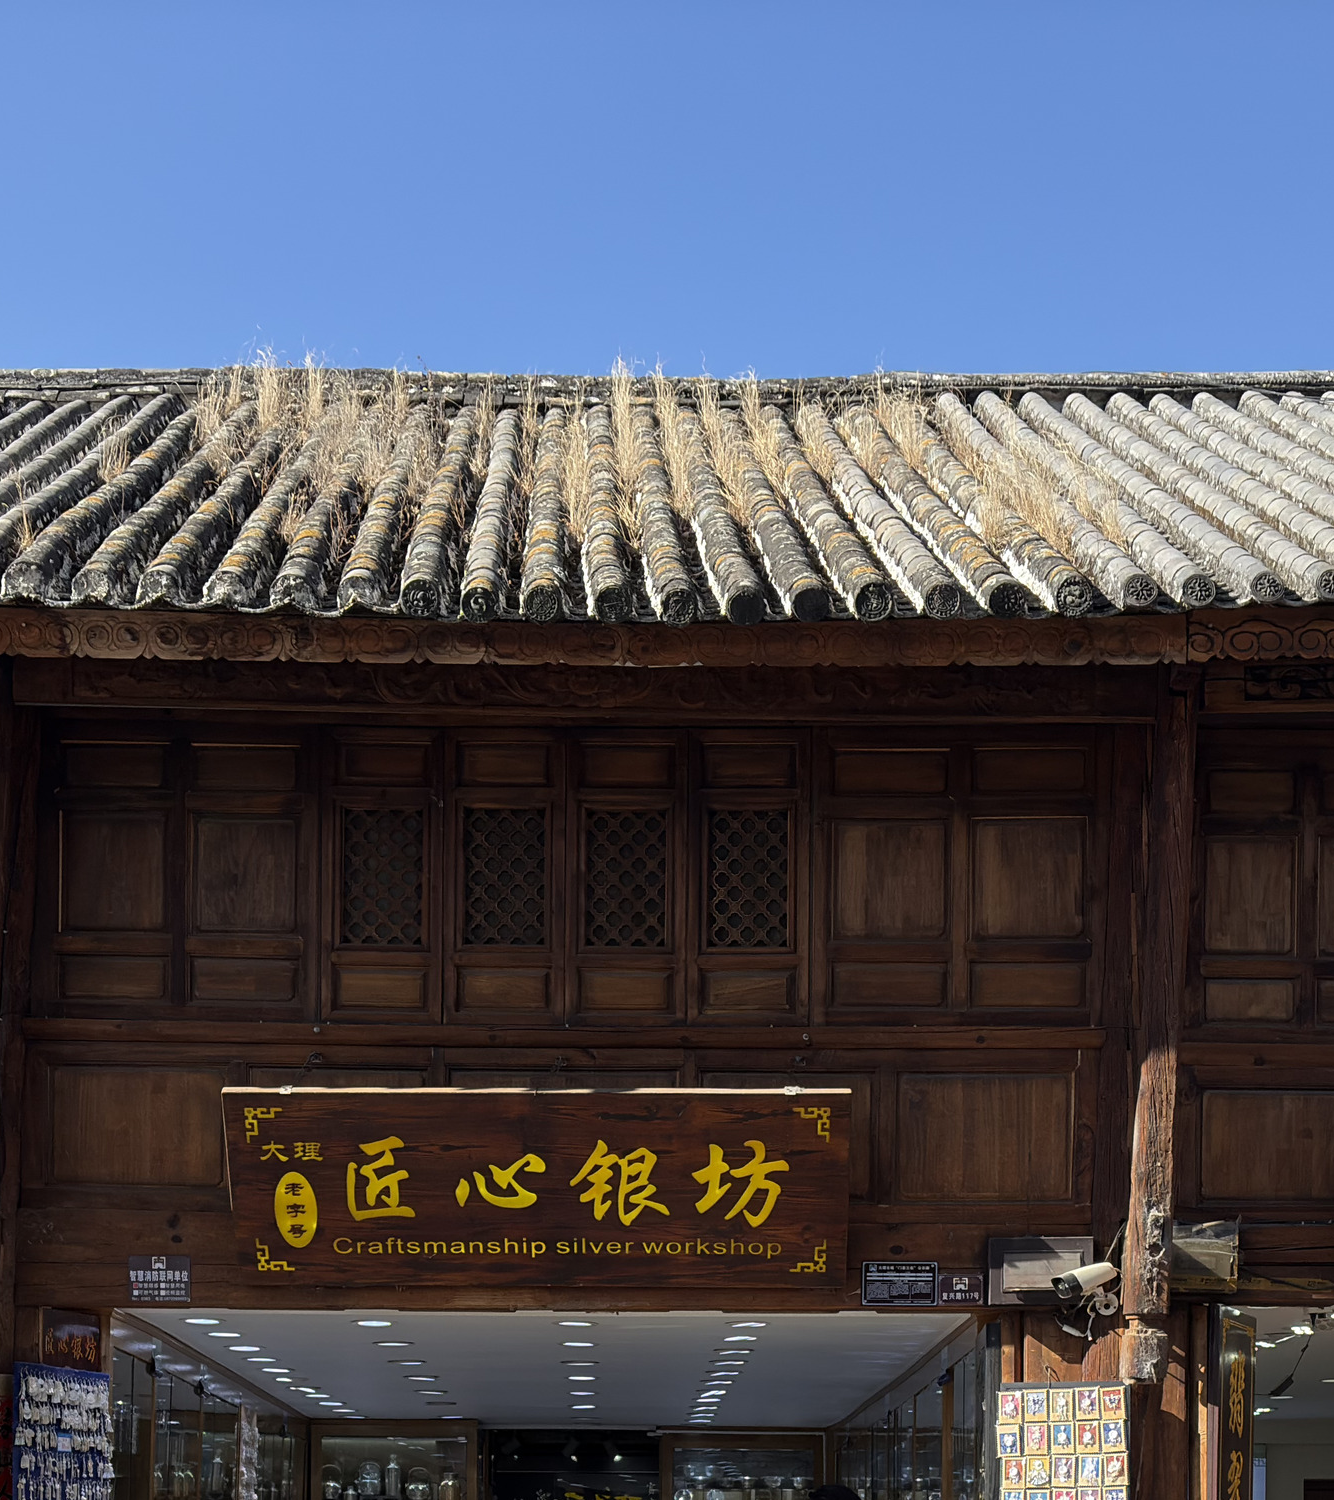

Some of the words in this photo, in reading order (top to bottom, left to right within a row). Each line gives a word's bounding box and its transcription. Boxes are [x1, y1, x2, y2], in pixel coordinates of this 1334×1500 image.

[260, 1140, 324, 1162] 大理
[346, 1134, 790, 1228] 匠心银坊
[284, 1181, 309, 1240] 老字号
[332, 1236, 547, 1258] Craftsmanship
[555, 1236, 634, 1255] silver
[641, 1236, 783, 1257] workshop
[129, 1270, 189, 1282] 智慧消防联网单位
[942, 1292, 980, 1301] 复兴路117号
